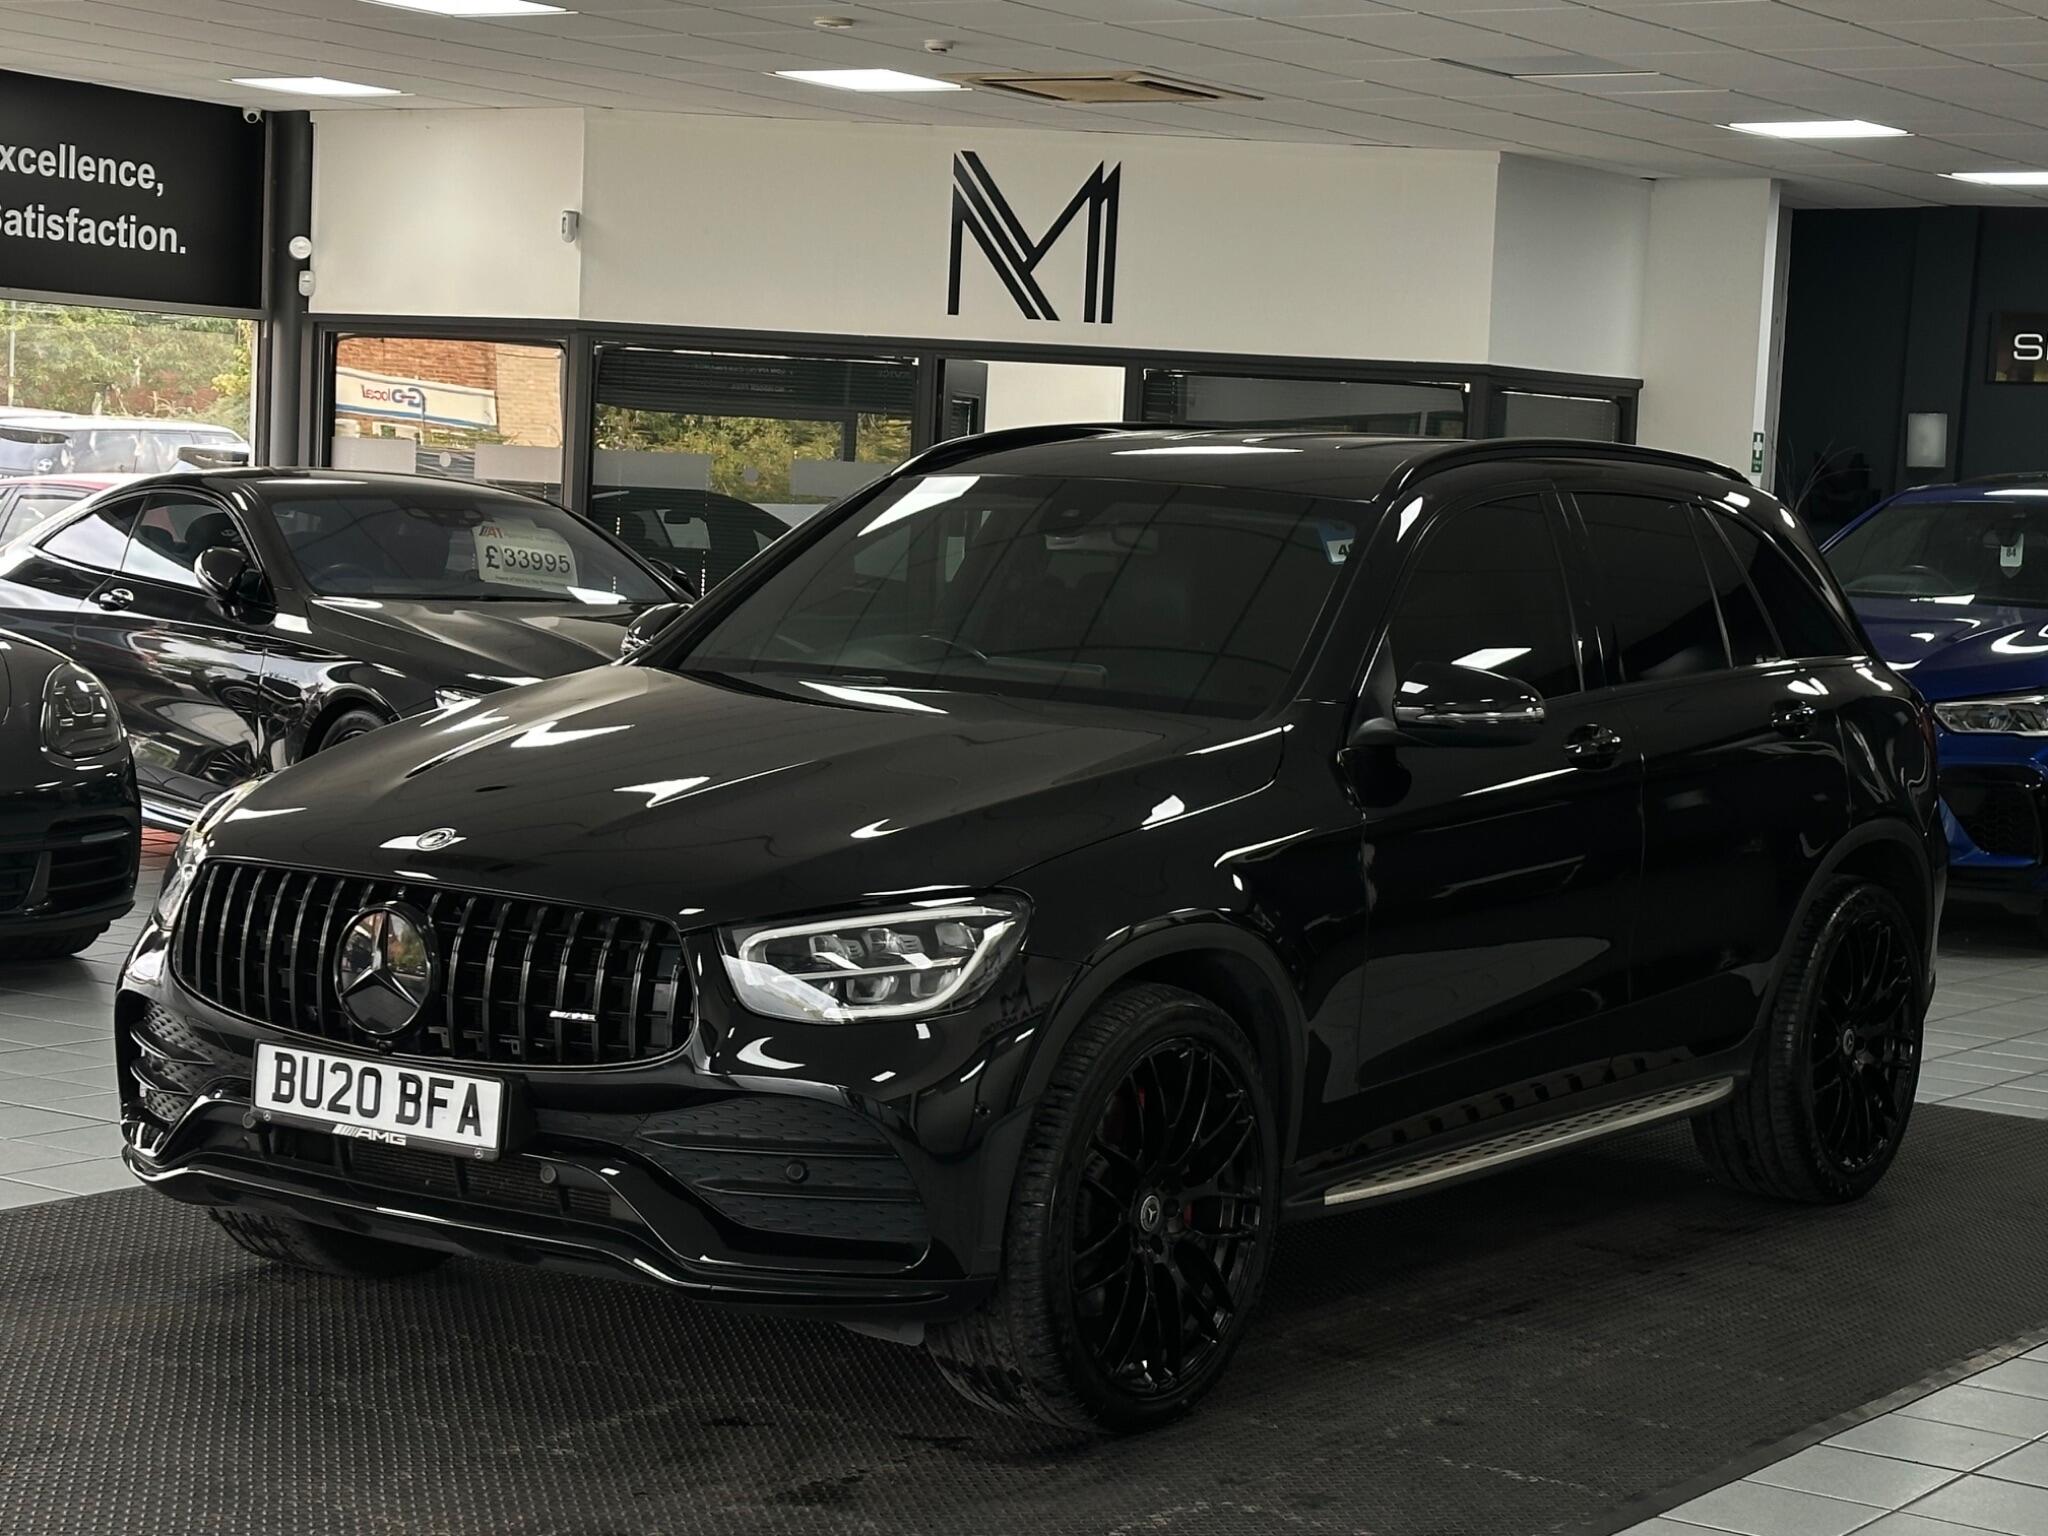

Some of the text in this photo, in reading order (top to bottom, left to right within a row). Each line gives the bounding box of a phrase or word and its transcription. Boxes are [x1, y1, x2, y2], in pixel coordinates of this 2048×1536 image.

[0, 203, 187, 254] atisfaction.
[2013, 333, 2048, 361] S
[271, 1051, 482, 1137] BU20 BFA
[355, 1127, 407, 1147] AMG
